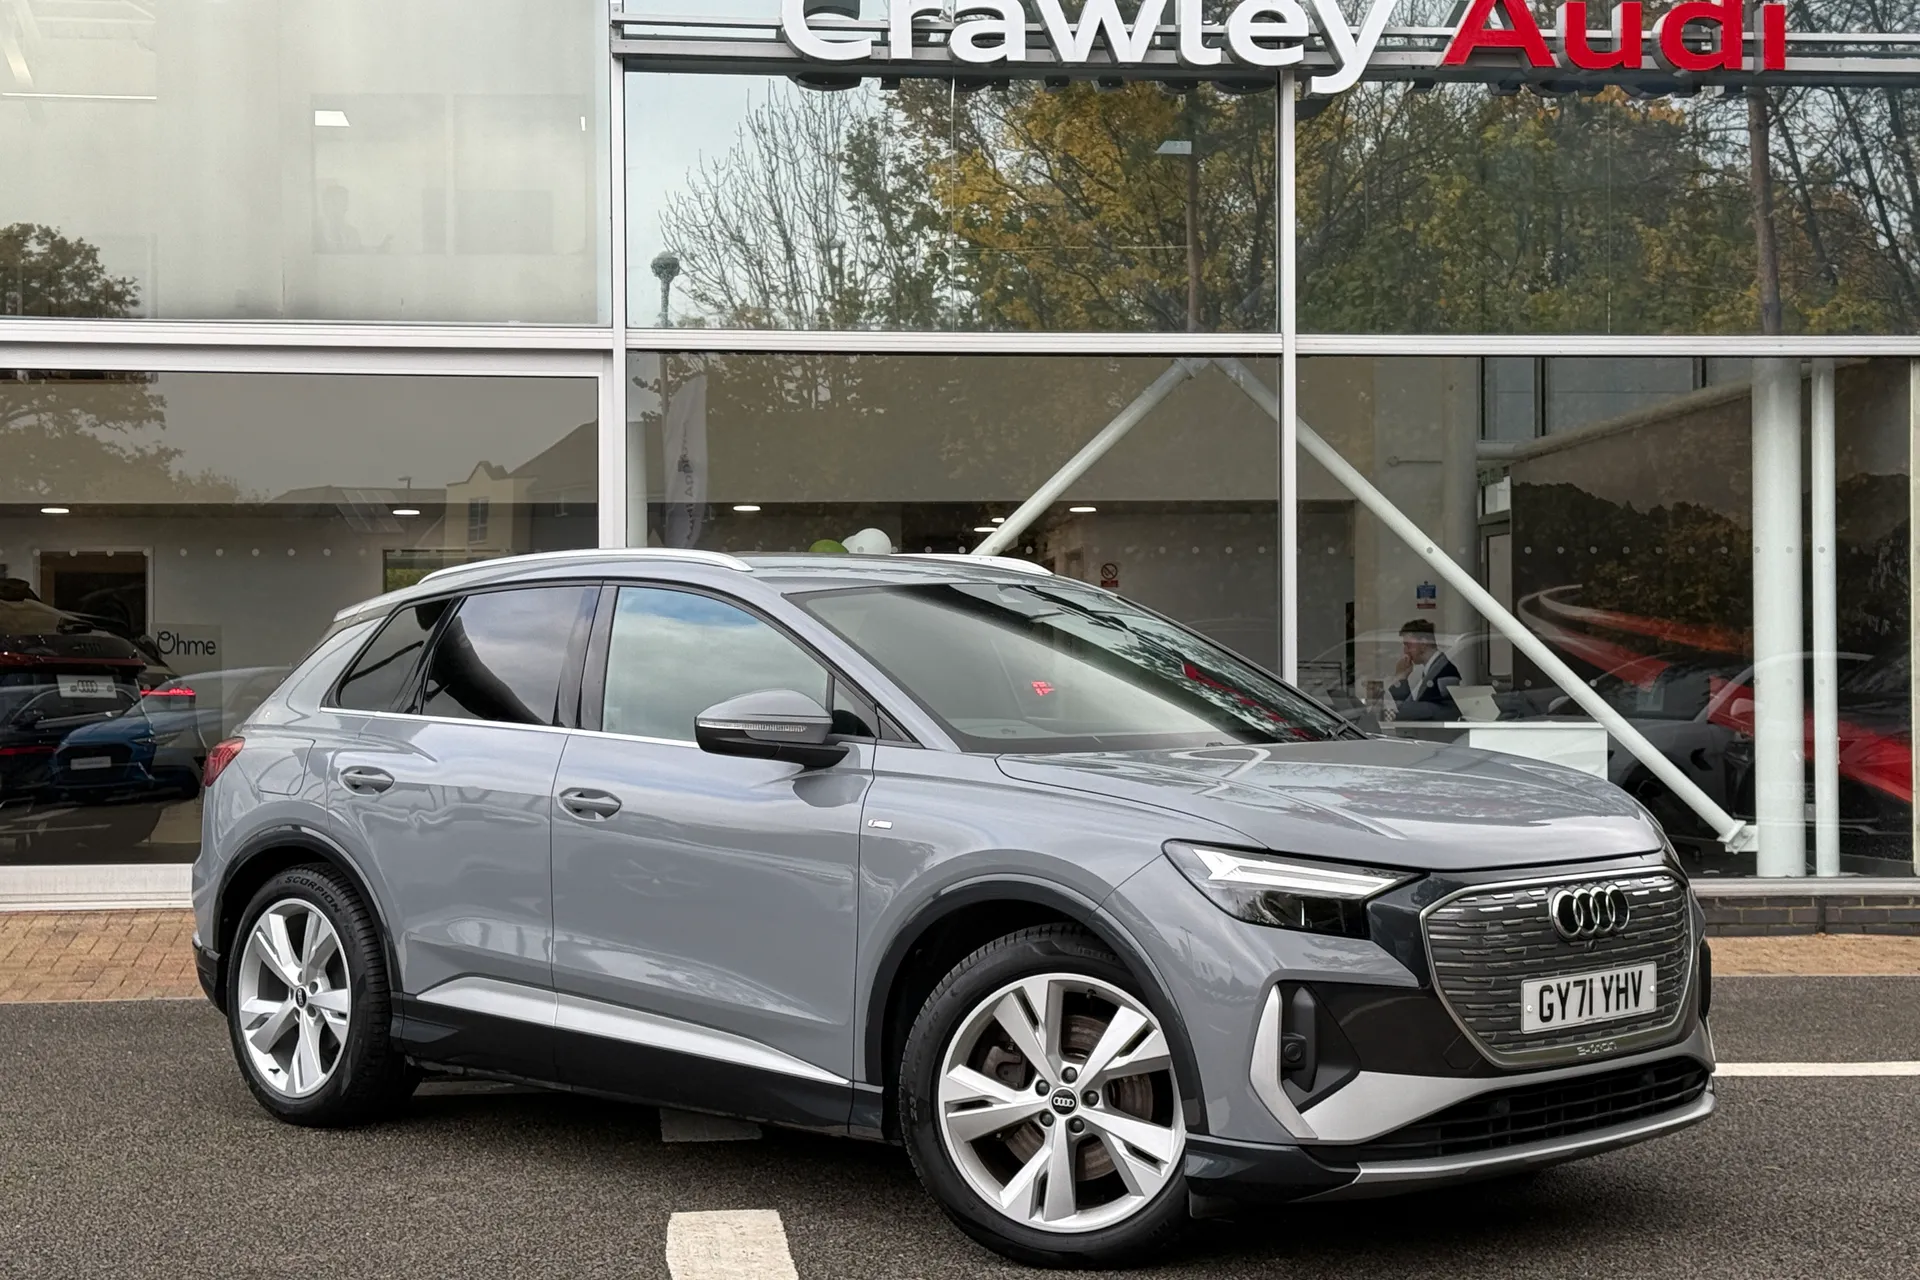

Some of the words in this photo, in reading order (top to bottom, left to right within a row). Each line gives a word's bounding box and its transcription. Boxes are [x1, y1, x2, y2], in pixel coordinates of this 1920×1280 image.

[781, 0, 1395, 95] Crawley
[1443, 0, 1785, 71] Audi
[157, 630, 216, 655] Ohme
[285, 876, 341, 913] SCORPION
[1539, 978, 1593, 1023] GY71
[1601, 970, 1643, 1013] YHV
